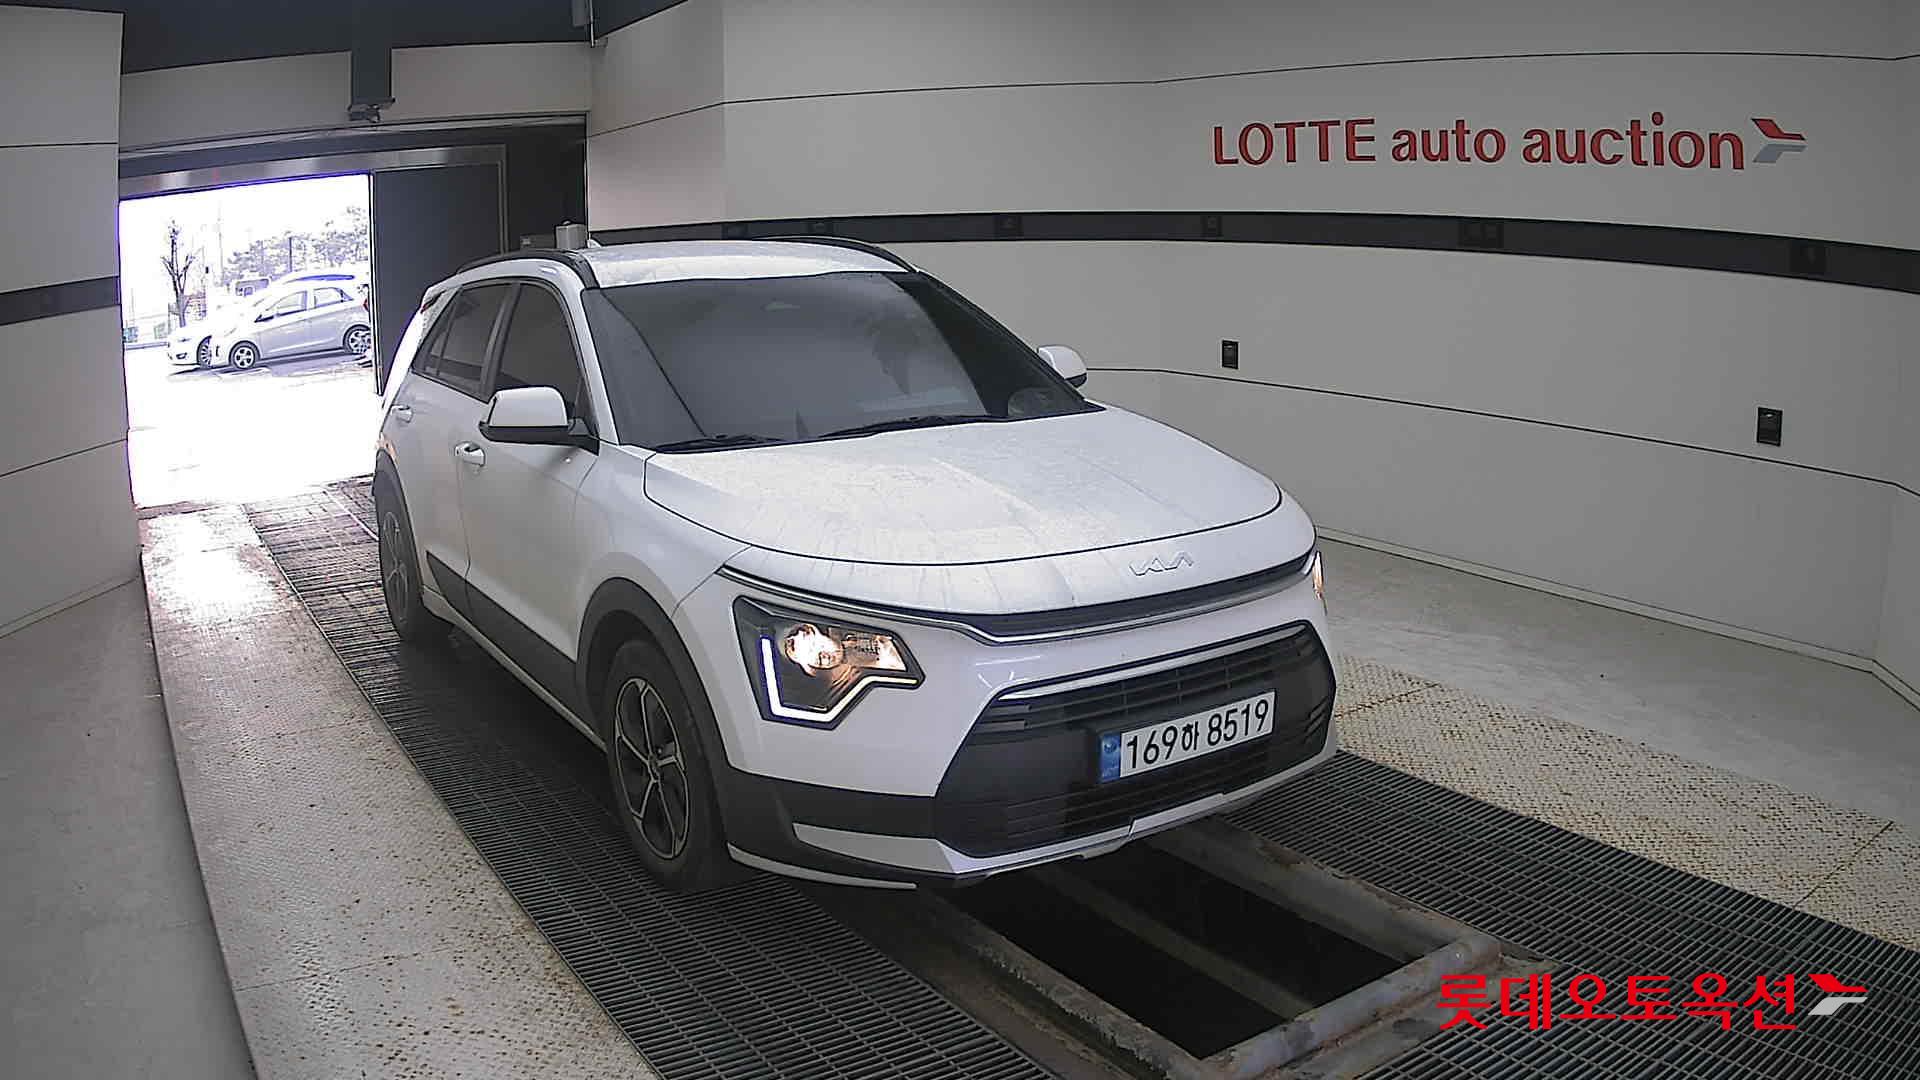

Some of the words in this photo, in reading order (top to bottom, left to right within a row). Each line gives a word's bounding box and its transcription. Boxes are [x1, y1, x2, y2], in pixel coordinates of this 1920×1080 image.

[1213, 118, 1376, 166] LOTTE
[1391, 119, 1506, 163] auto
[1521, 112, 1745, 170] auction
[1126, 720, 1200, 769] 169하
[1206, 699, 1270, 747] 8519
